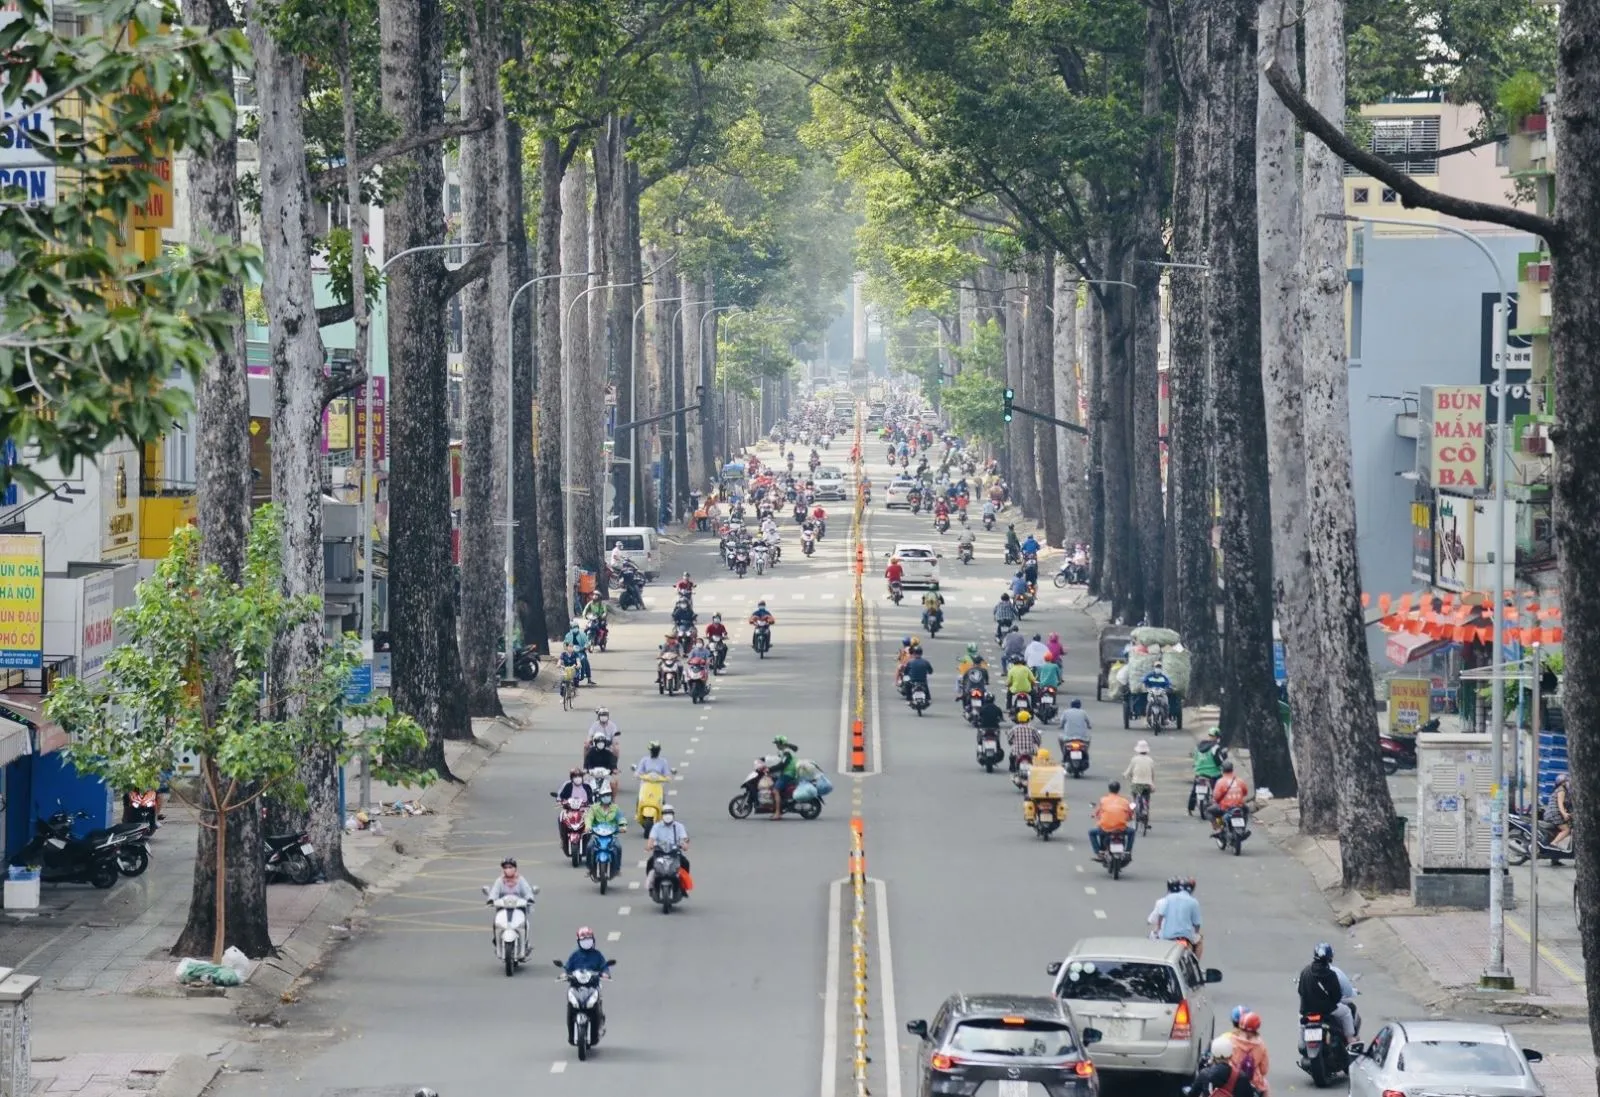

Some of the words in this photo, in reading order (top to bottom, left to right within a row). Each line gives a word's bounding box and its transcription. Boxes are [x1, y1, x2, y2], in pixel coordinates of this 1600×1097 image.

[1437, 388, 1482, 410] BÚN
[358, 412, 381, 422] BN
[1434, 412, 1483, 438] MẮM
[1439, 442, 1476, 463] CÔ
[1438, 468, 1477, 486] BA
[0, 561, 15, 577] ÚN
[17, 584, 35, 603] NỘI
[0, 608, 15, 623] ÚN
